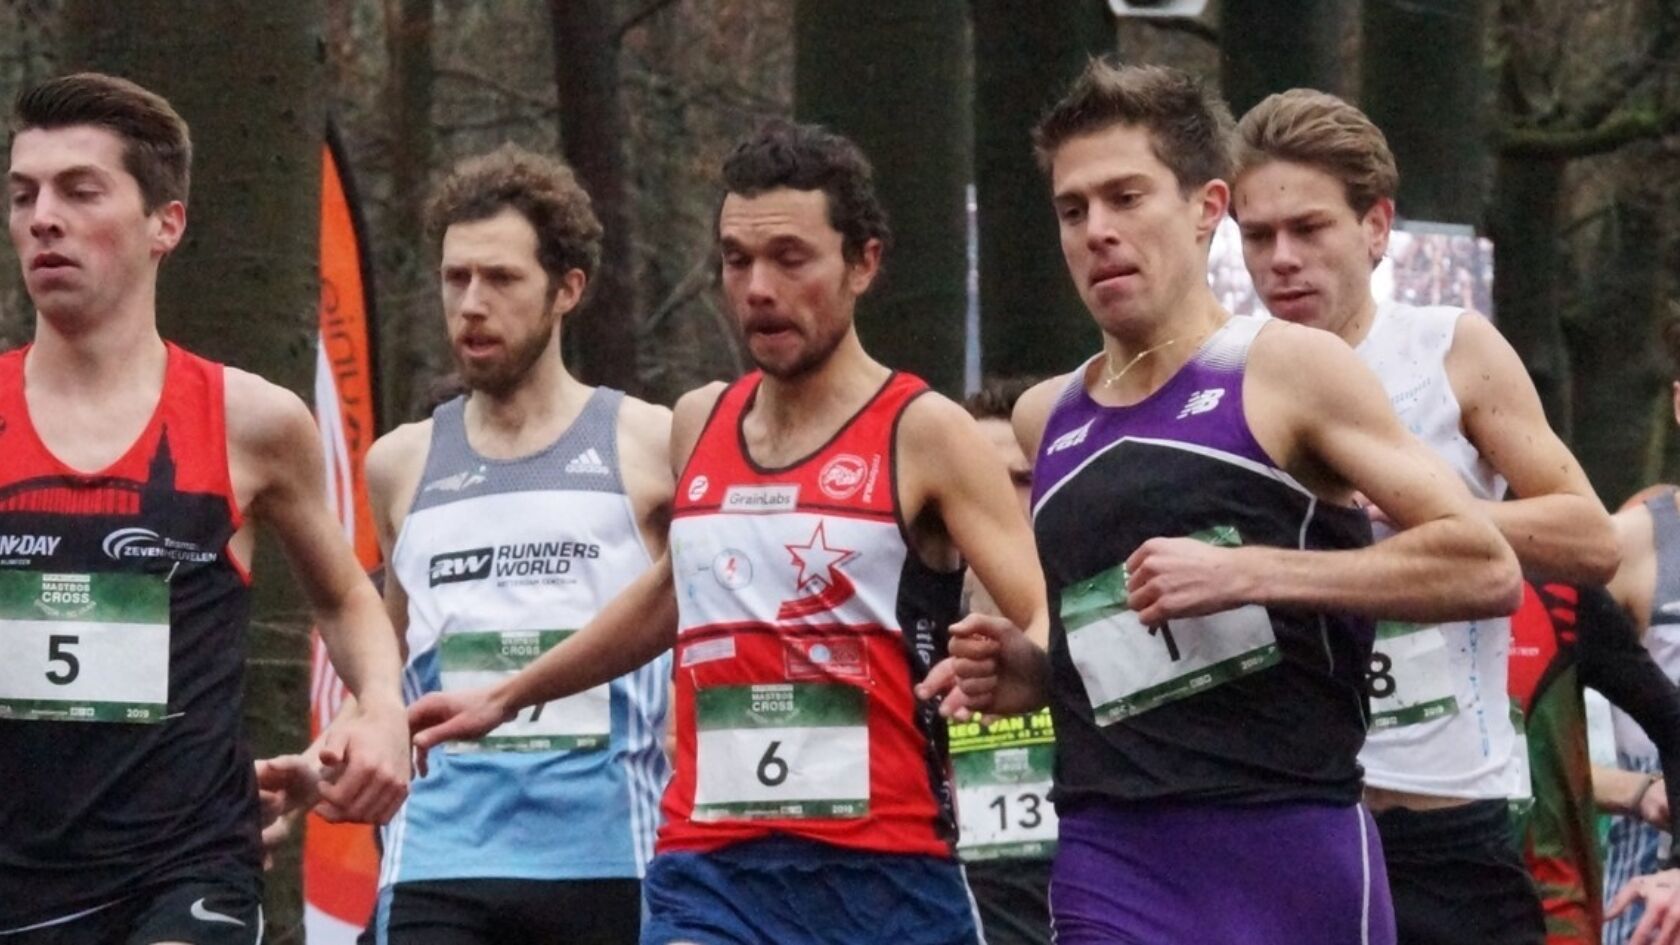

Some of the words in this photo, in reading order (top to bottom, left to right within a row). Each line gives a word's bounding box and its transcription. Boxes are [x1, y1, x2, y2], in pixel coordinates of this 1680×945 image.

[729, 491, 791, 504] GrainLabs
[124, 545, 217, 563] ZEVENHEUVELEN
[499, 541, 600, 560] RUNNERS
[432, 553, 490, 579] RW
[496, 560, 570, 577] WORLD
[42, 582, 90, 592] MASTBOS
[42, 591, 90, 604] CROSS
[501, 645, 541, 656] CROSS
[45, 634, 80, 685] 5
[1365, 652, 1396, 698] 8
[126, 708, 149, 719] 2019
[751, 700, 794, 712] CROSS
[988, 717, 1025, 733] VAN
[756, 741, 789, 787] 6
[832, 804, 854, 815] 2019
[989, 793, 1042, 831] 13
